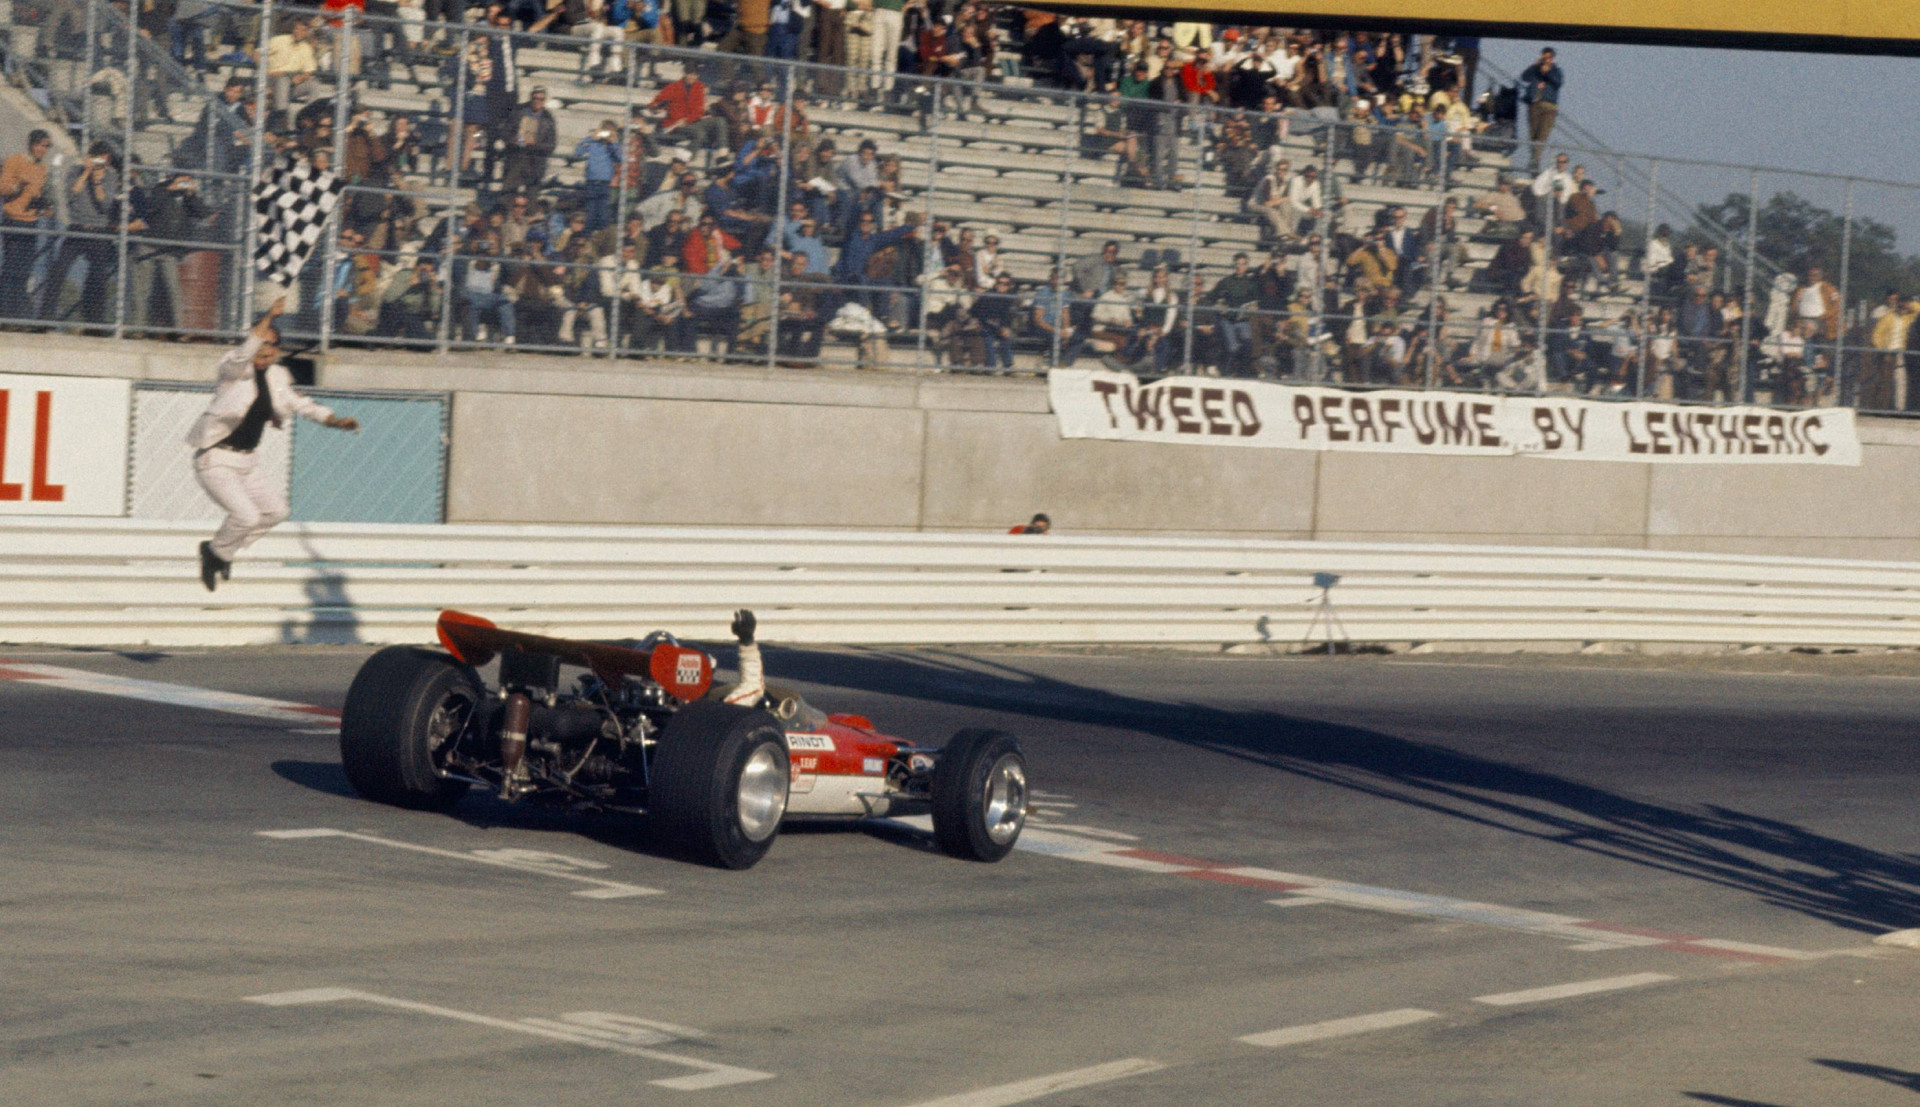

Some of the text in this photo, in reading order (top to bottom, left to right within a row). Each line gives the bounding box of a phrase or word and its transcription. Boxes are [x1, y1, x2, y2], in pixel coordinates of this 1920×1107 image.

[1092, 380, 1830, 457] TWEED PERFUME BY LENTHERIC
[789, 736, 826, 748] RINDT
